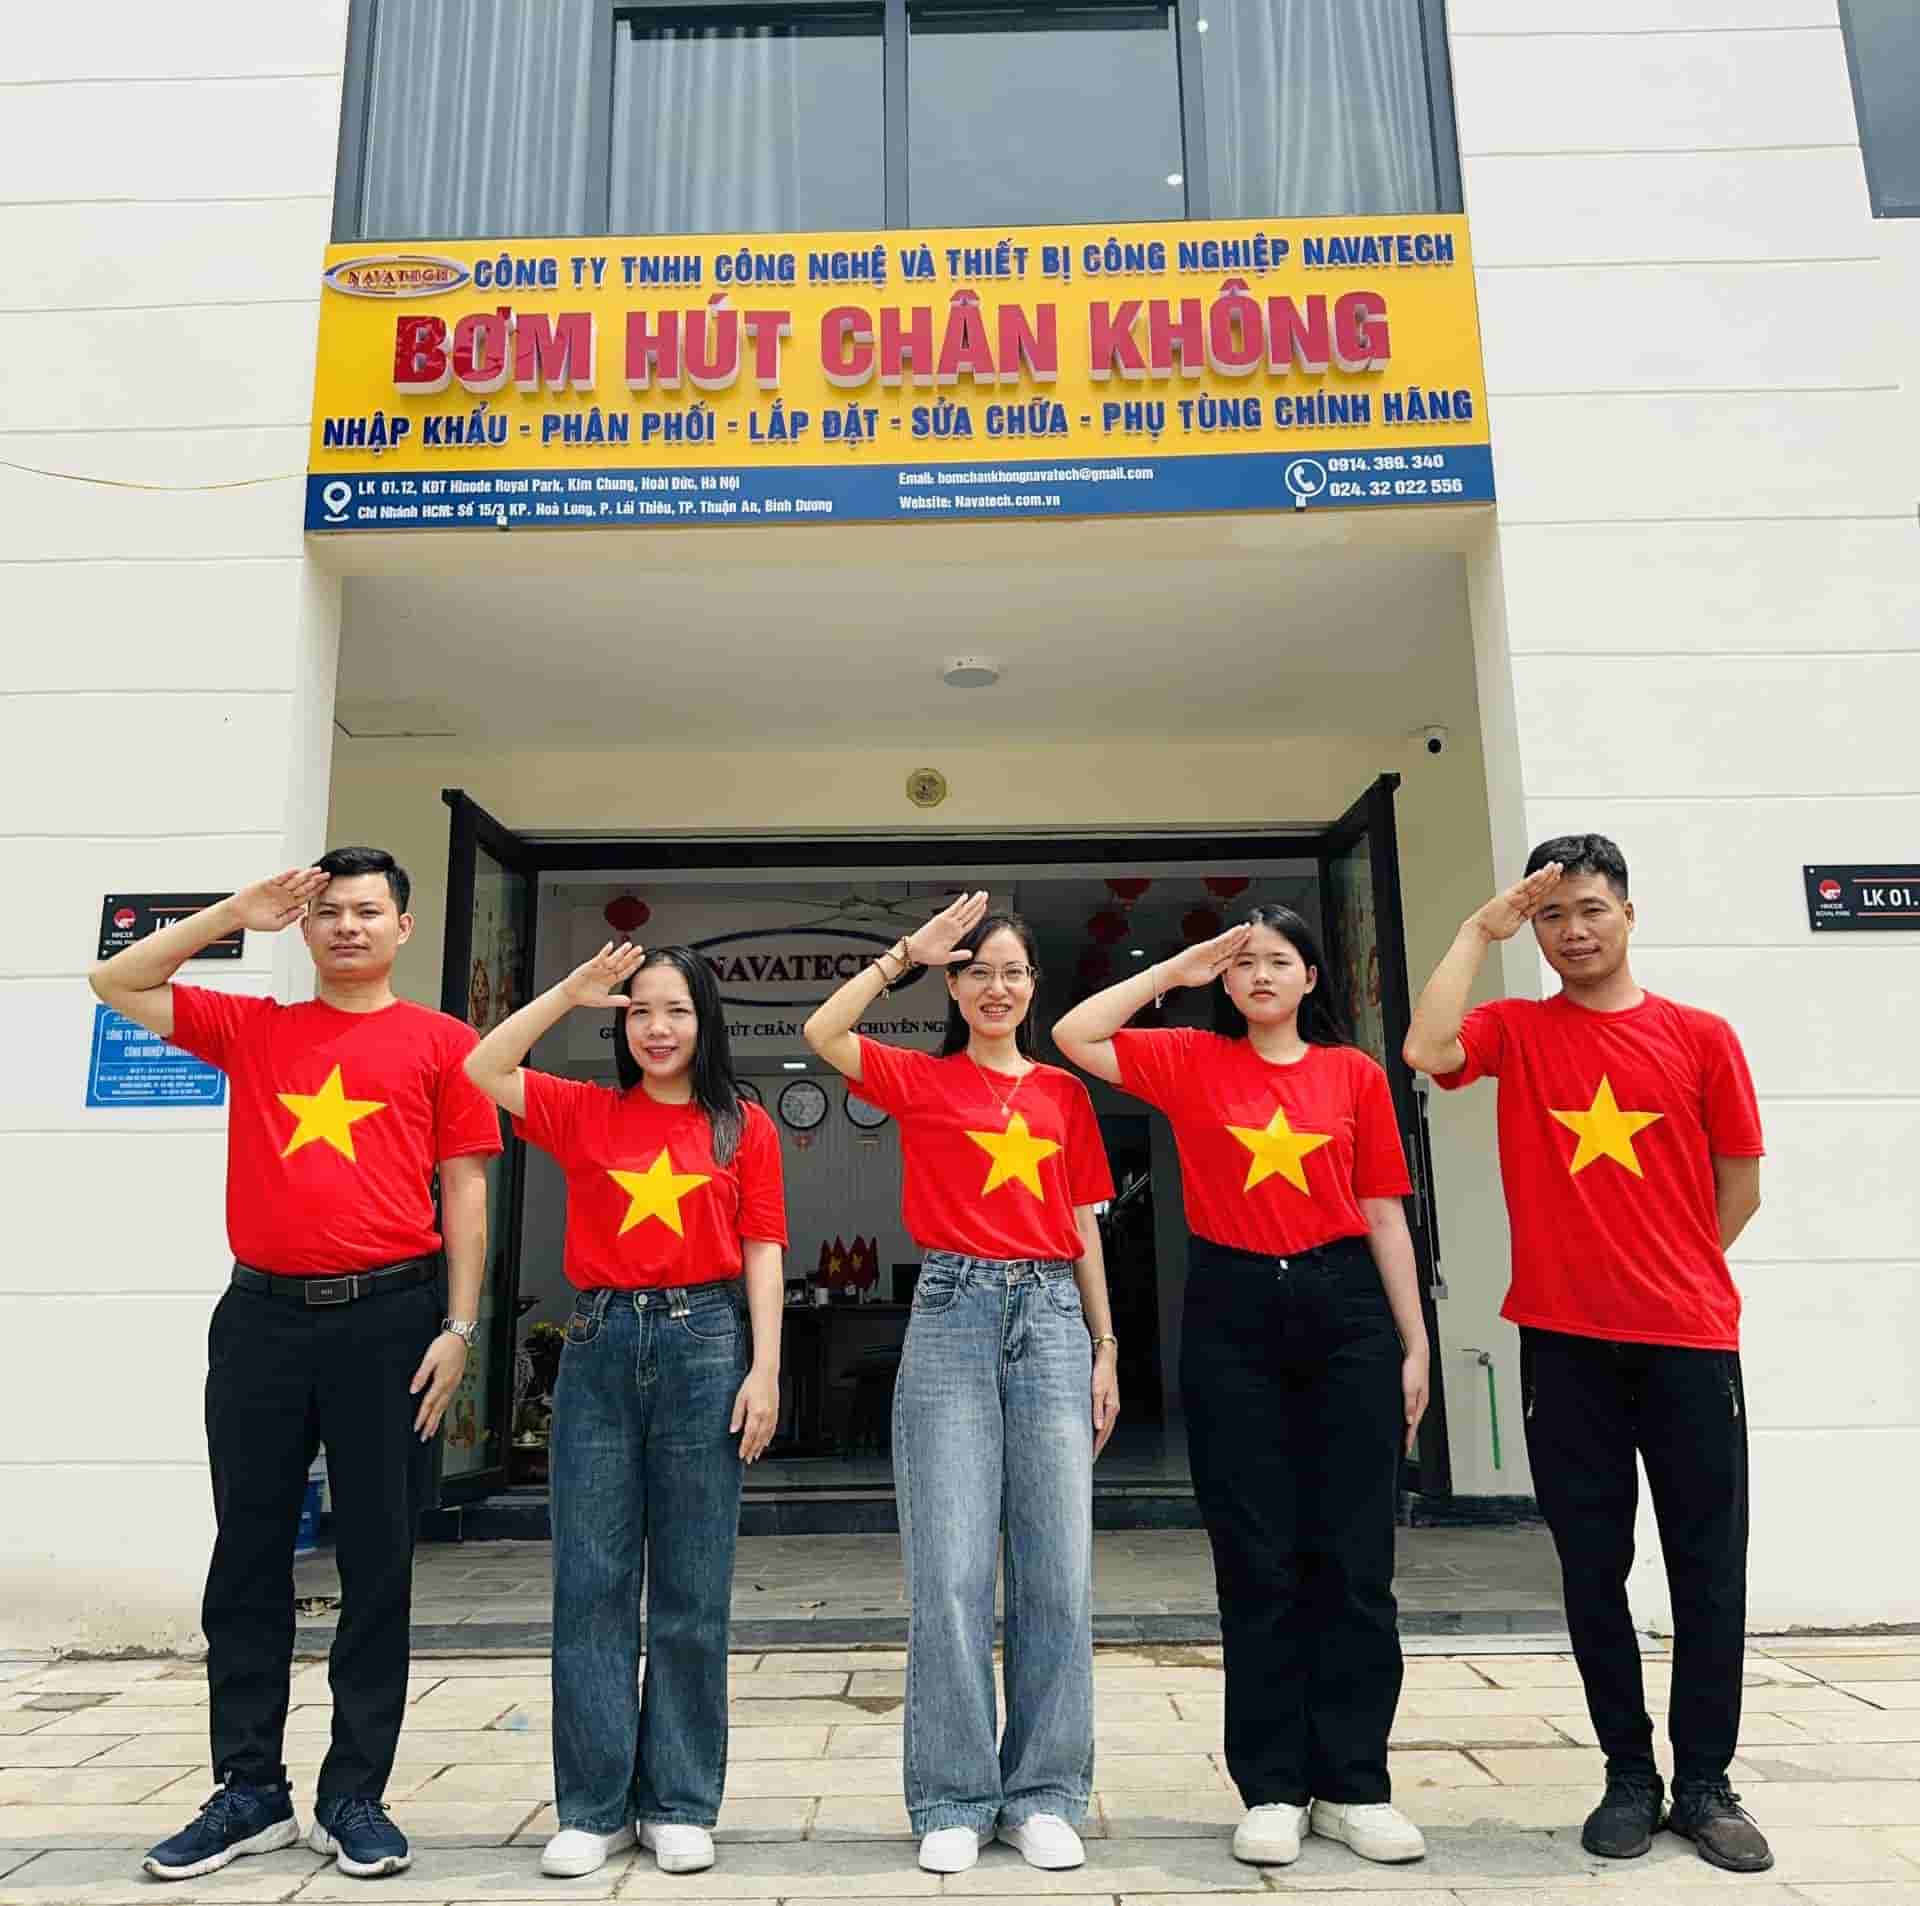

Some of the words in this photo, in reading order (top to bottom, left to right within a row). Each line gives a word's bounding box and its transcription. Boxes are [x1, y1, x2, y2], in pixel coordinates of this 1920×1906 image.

[475, 253, 557, 288] CÔNG
[571, 257, 606, 286] TY
[620, 255, 702, 285] TNHH
[715, 247, 795, 284] CÔNG
[808, 244, 887, 287] NGHỆ
[900, 243, 936, 280] VÀ
[946, 238, 1029, 278] THIẾT
[1042, 245, 1070, 281] BỊ
[1083, 237, 1166, 274] CÔNG
[1178, 232, 1290, 276] NGHIỆP
[1303, 234, 1455, 267] NAVATECH
[393, 306, 594, 388] BƠM
[625, 293, 792, 384] HÚT
[820, 289, 1058, 382] CHÂN
[1089, 278, 1392, 376] KHÔNG
[323, 410, 411, 453] NHẬP
[422, 401, 508, 446] KHẨU
[542, 407, 630, 444] PHÂN
[641, 400, 715, 442] PHỐI
[750, 397, 810, 441] LẮP
[822, 401, 879, 448] ĐẶT
[911, 396, 973, 438] SỬA
[985, 396, 1069, 436] CHỮA
[1102, 401, 1165, 439] PHỤ
[1177, 392, 1262, 430] TÙNG
[1275, 388, 1371, 427] CHÍNH
[1383, 386, 1473, 423] HÃNG
[358, 480, 376, 496] LK
[450, 479, 491, 494] Hinode
[495, 478, 529, 494] Royal
[567, 478, 593, 492] Kim
[595, 477, 638, 494] Chung,
[701, 475, 717, 490] Hà
[720, 475, 740, 491] Nội
[898, 471, 934, 486] Email:
[1369, 480, 1391, 497] 32
[1394, 479, 1427, 496] 022
[357, 505, 377, 520] Chi
[379, 503, 418, 519] Nhánh
[457, 500, 474, 517] Số
[509, 503, 531, 517] KP.
[535, 502, 559, 517] Hoà
[562, 501, 596, 518] Long,
[599, 501, 613, 516] P.
[616, 500, 635, 515] Lái
[639, 500, 675, 516] Thiêu,
[678, 500, 697, 515] TP.
[699, 499, 736, 516] Thuận
[741, 500, 760, 516] An,
[765, 498, 792, 514] Bình
[898, 494, 952, 510] Website:
[954, 493, 1061, 509] Navatech.com.vn
[1862, 889, 1885, 907] LK
